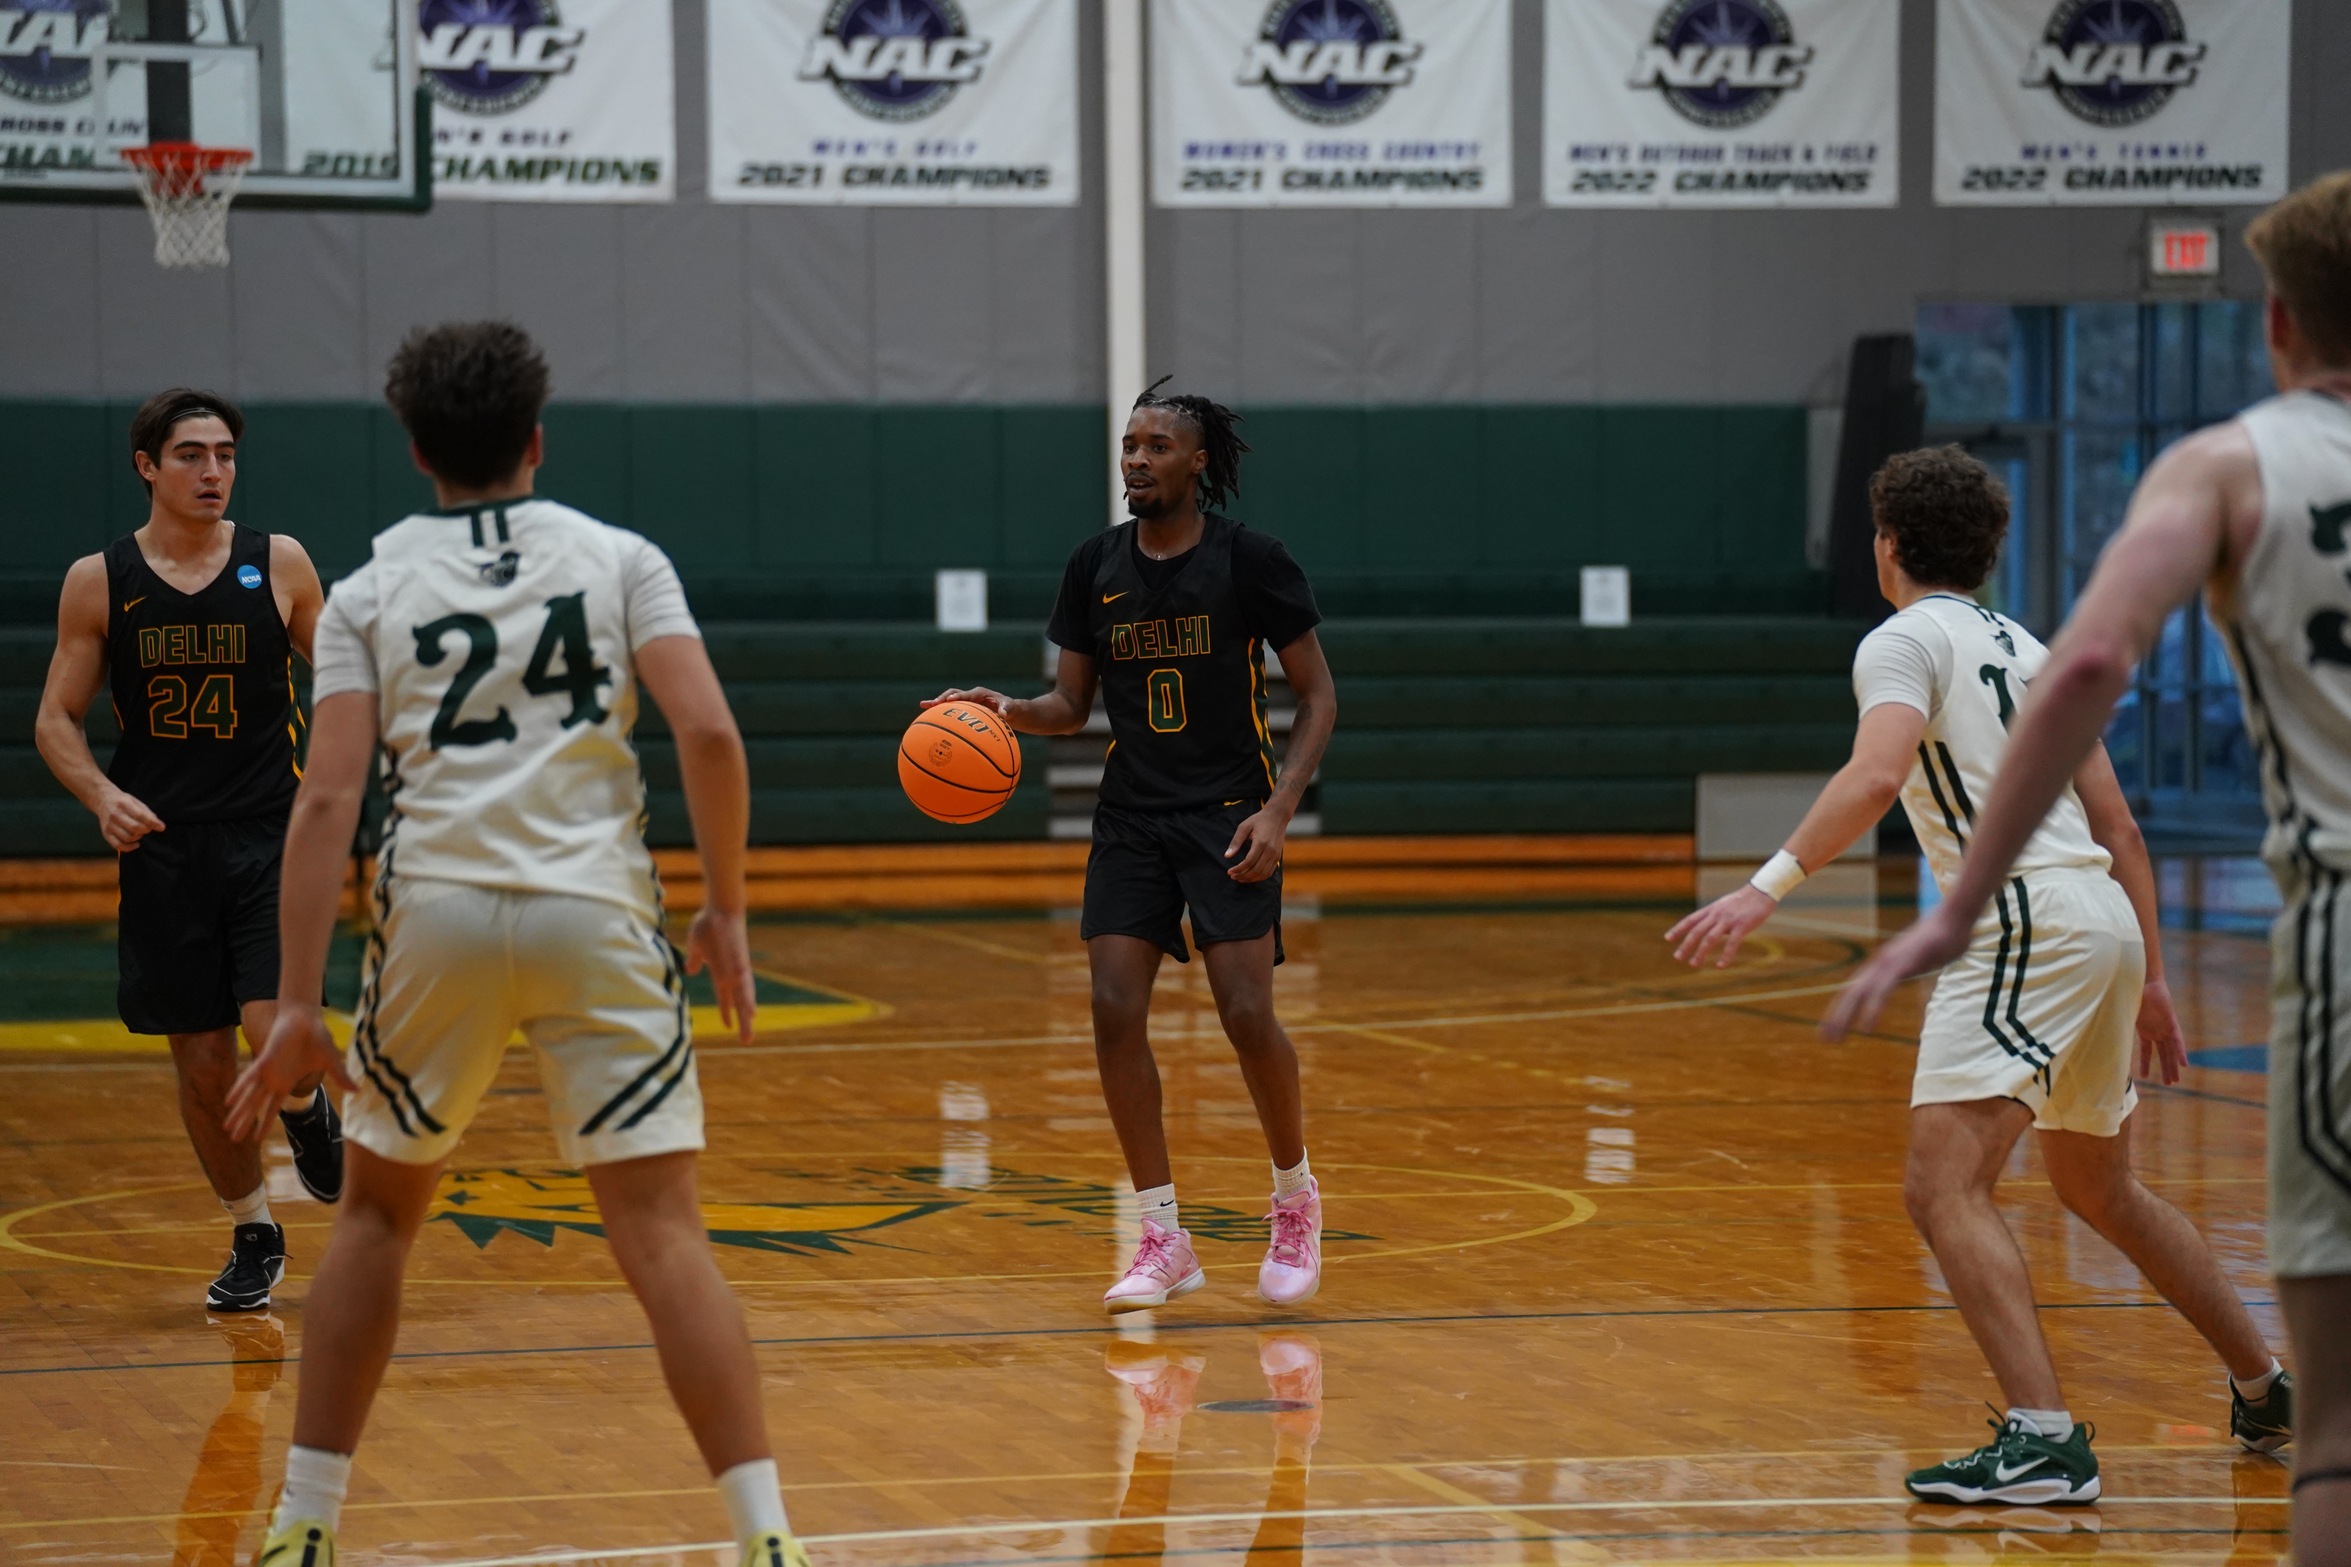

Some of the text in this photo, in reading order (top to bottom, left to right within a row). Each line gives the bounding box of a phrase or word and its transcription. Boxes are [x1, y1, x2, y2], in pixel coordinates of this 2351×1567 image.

[797, 34, 992, 82] NAC
[1235, 40, 1425, 86] NAC
[1625, 44, 1815, 89] NAC
[2020, 42, 2208, 88] NAC
[737, 162, 1053, 191] 2021 CHAMPIONS
[1180, 167, 1484, 193] 2021 CHAMPIONS
[1570, 169, 1873, 194] 2022 CHAMPIONS
[1960, 165, 2264, 192] 2022 CHAMPIONS
[2164, 231, 2208, 271] EXIT
[240, 574, 263, 585] NCAA
[138, 624, 247, 669] DELHI
[1111, 615, 1212, 661] DELHI
[412, 589, 614, 754] 24
[147, 674, 238, 740] 24
[942, 707, 991, 734] EVO
[1147, 668, 1188, 734] 0
